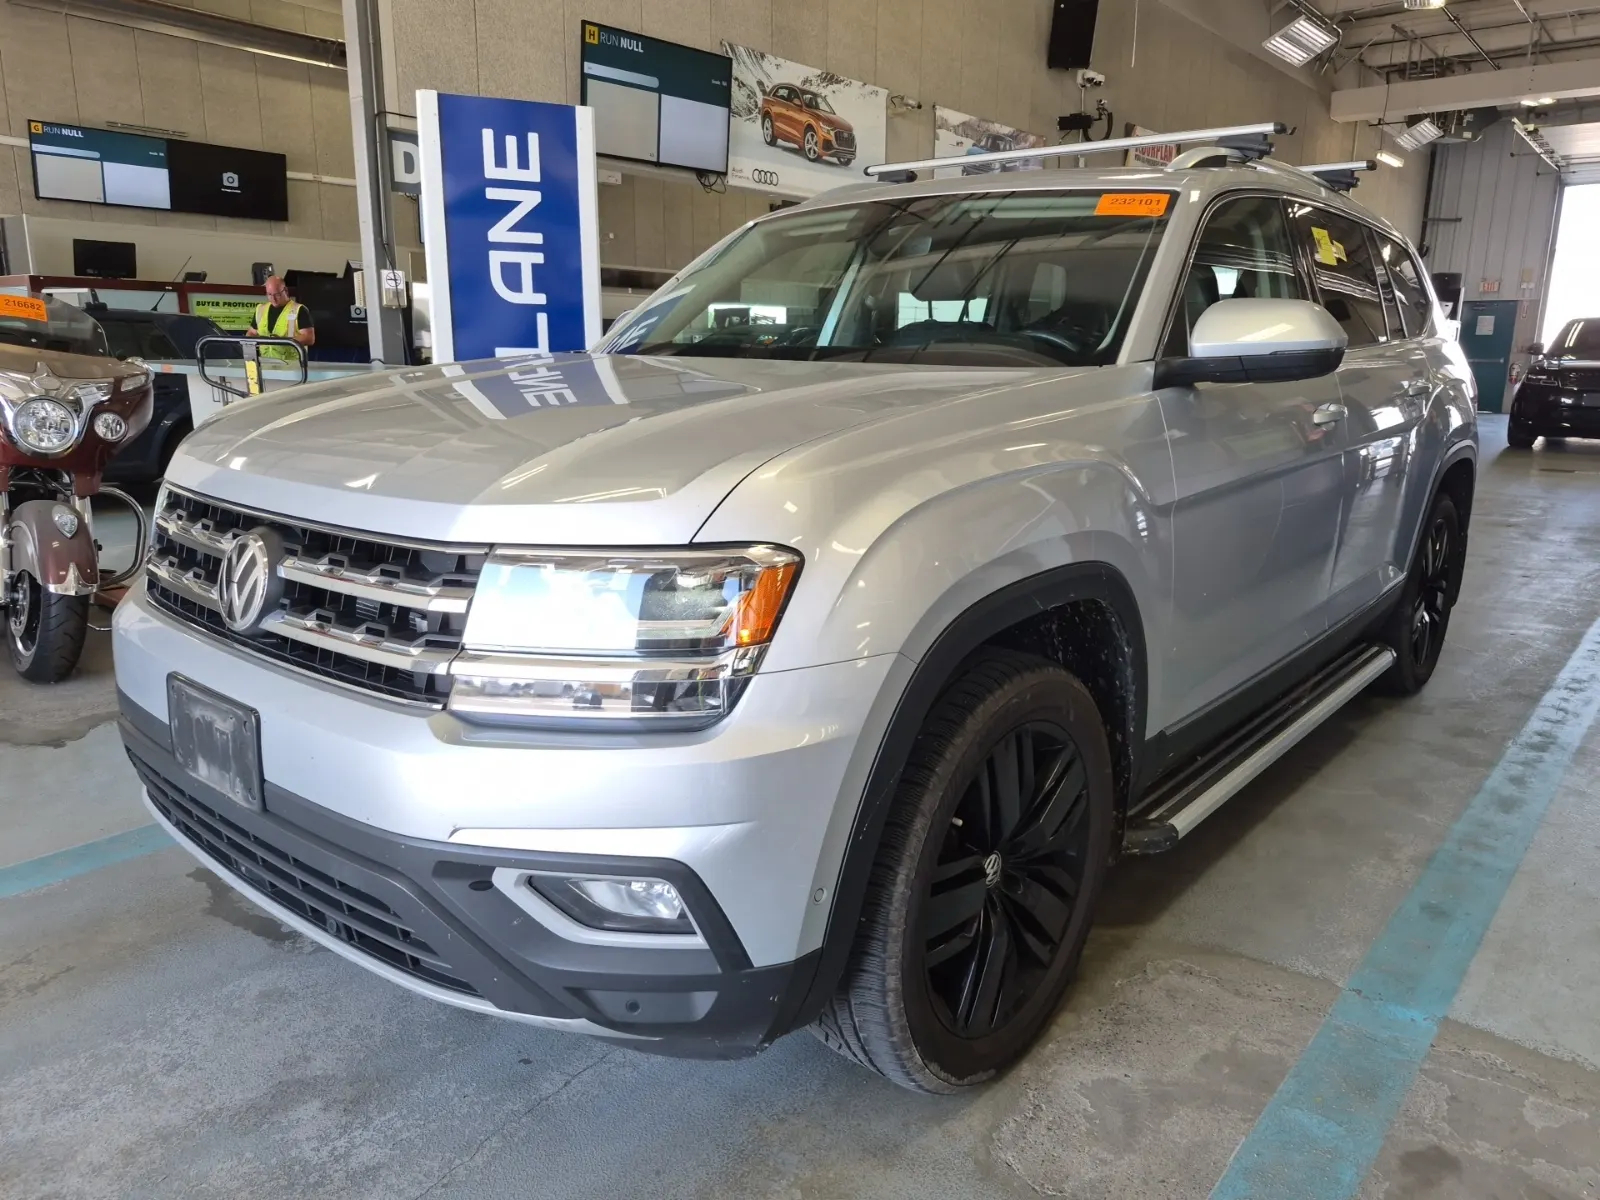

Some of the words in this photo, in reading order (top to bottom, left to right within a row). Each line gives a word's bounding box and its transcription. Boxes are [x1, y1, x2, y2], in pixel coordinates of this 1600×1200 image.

[588, 29, 596, 41] H
[600, 32, 620, 47] RUN
[620, 37, 644, 53] NULL
[33, 124, 40, 132] G
[43, 126, 61, 135] RUN
[61, 128, 84, 138] NULL
[391, 139, 421, 184] D
[1110, 198, 1161, 206] 232101
